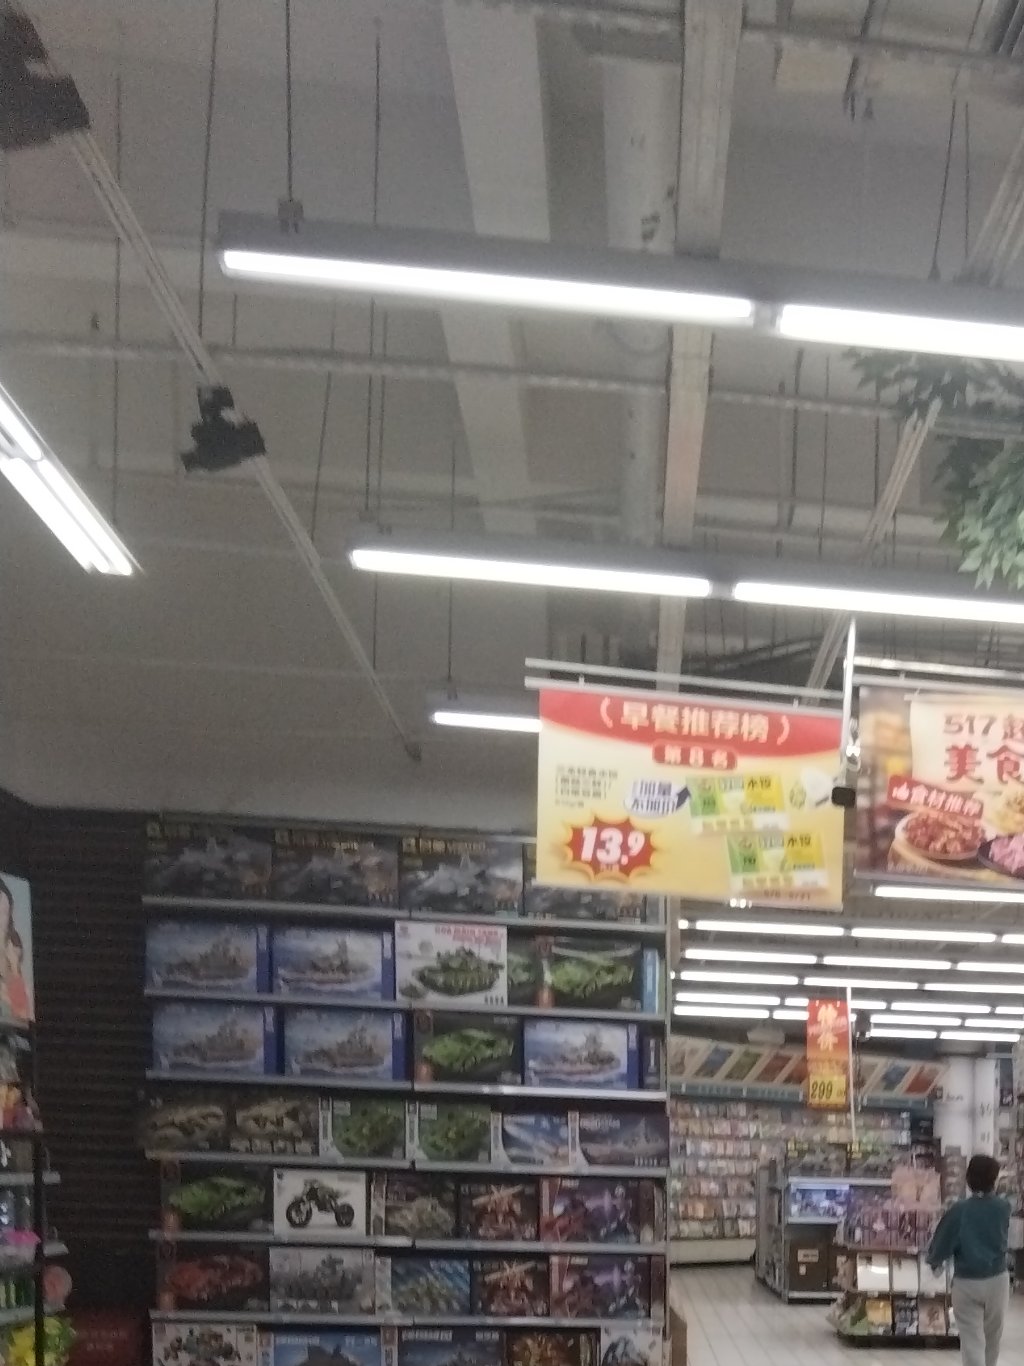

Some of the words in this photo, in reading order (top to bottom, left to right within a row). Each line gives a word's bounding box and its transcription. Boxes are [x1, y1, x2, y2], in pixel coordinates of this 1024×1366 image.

[620, 701, 770, 744] 早餐推荐榜
